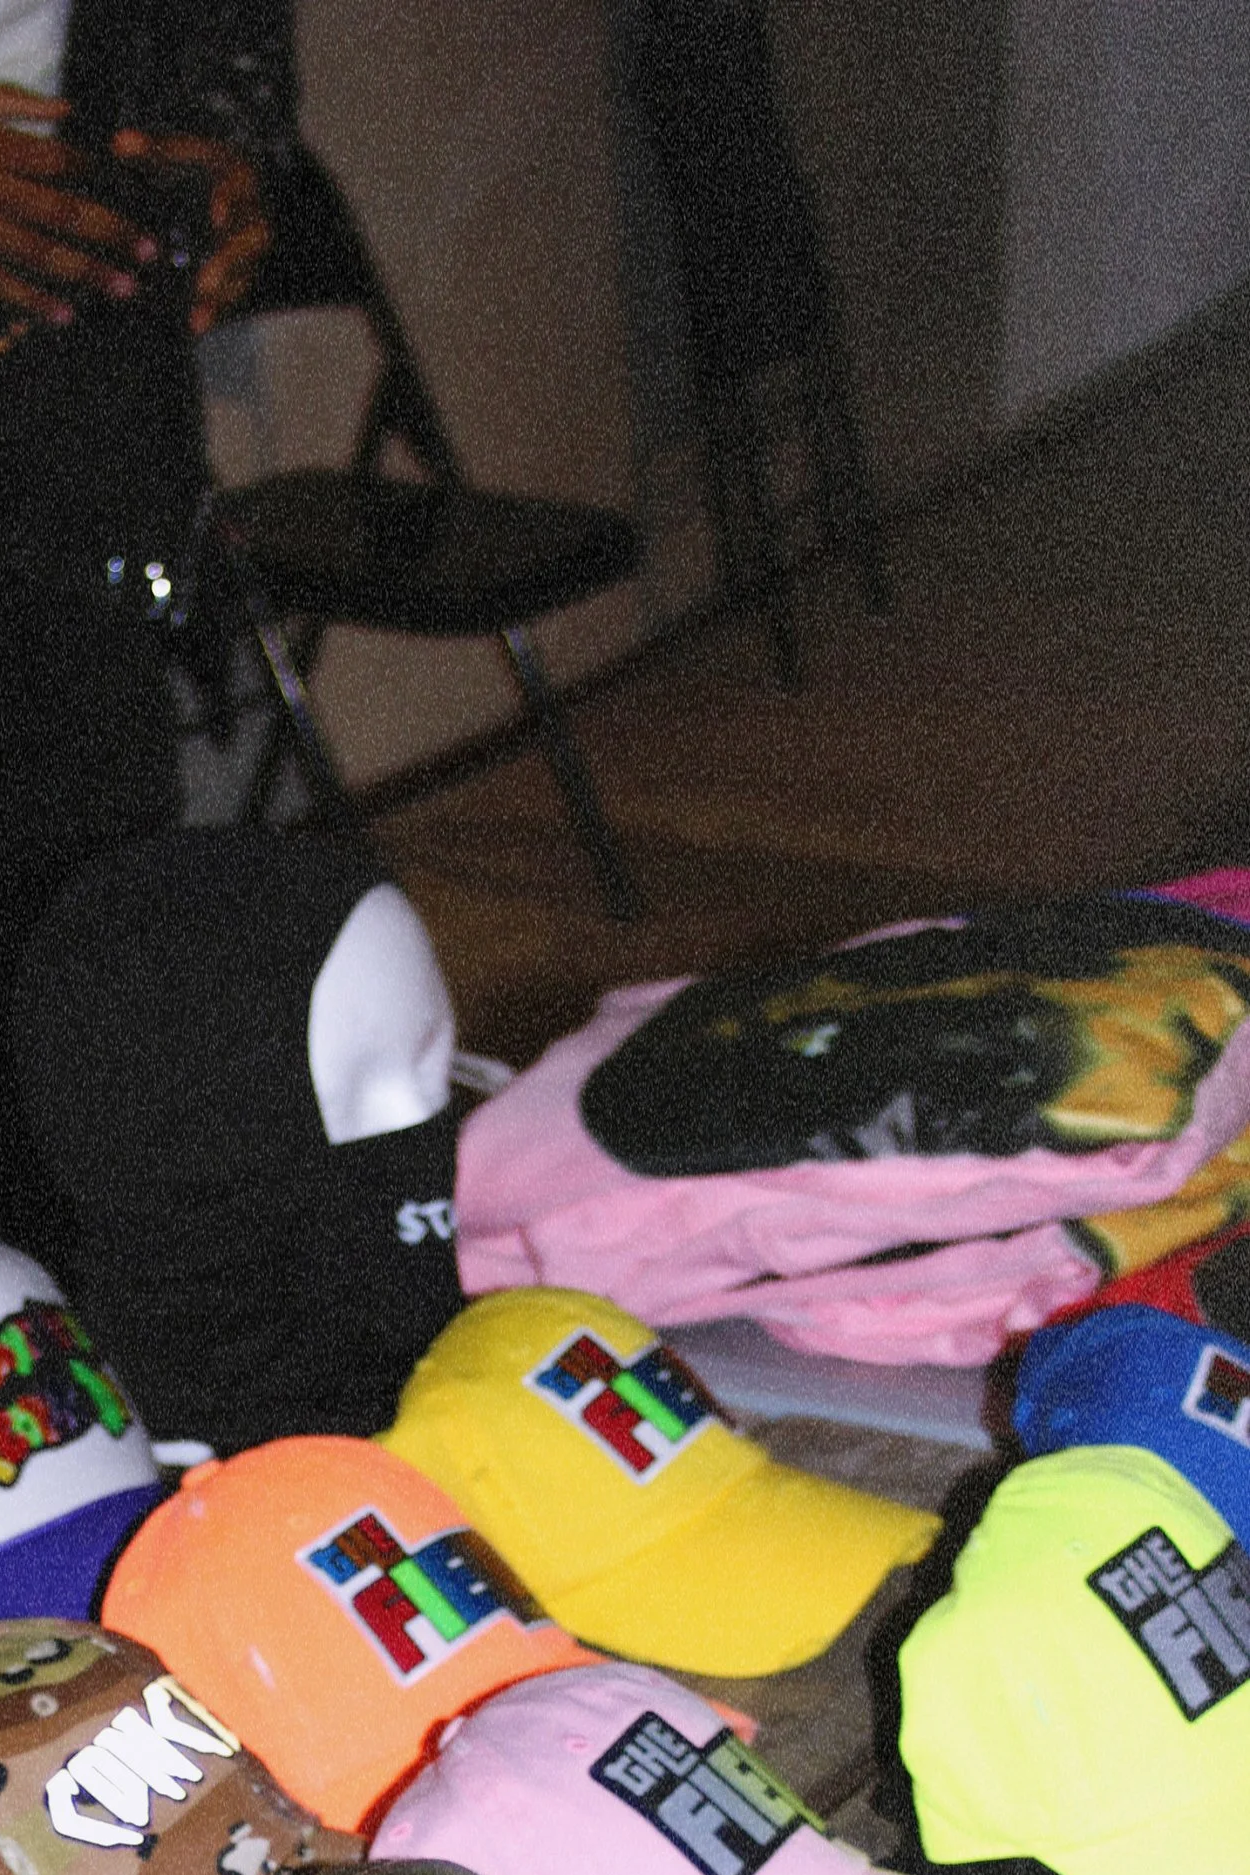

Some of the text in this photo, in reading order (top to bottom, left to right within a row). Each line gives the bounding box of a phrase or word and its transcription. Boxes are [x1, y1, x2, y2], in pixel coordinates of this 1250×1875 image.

[396, 1199, 457, 1246] ST
[1100, 1537, 1193, 1611] THE
[604, 1721, 700, 1797] THE
